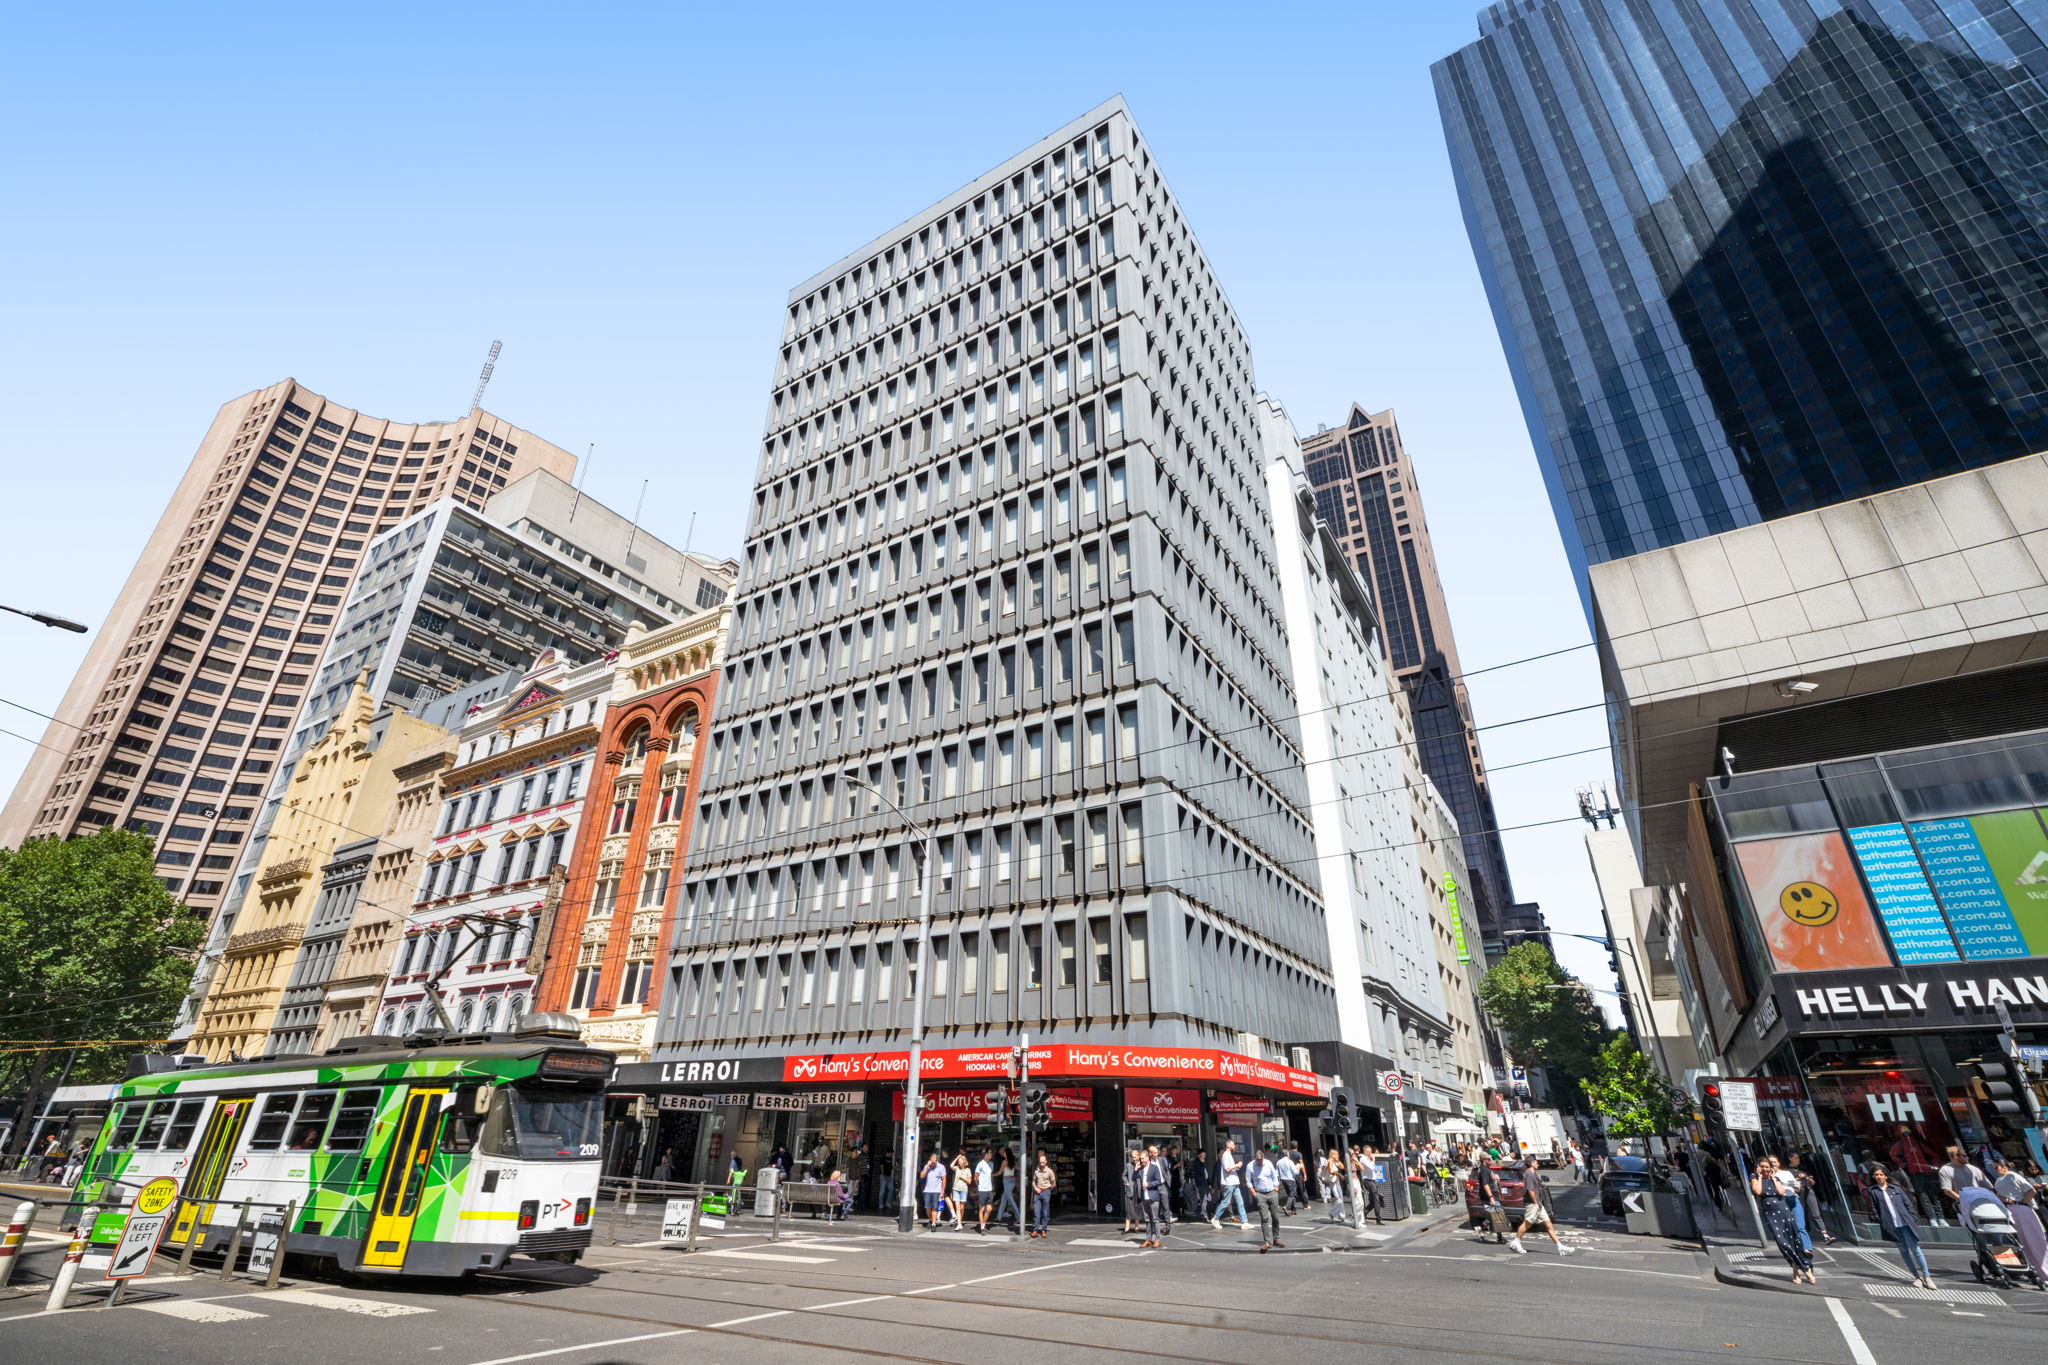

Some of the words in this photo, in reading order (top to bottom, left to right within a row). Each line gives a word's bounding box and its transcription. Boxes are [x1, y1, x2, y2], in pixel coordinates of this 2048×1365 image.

[204, 810, 214, 818] 12
[1796, 983, 1928, 1014] HELLY
[958, 1053, 994, 1062] AMERICAN
[1069, 1050, 1119, 1069] Harry's
[1124, 1052, 1214, 1070] Convenience
[661, 1061, 740, 1081] LERROI
[819, 1057, 860, 1076] Harry's
[864, 1056, 944, 1072] Convennce
[966, 1063, 996, 1071] HOOKAH
[1233, 1058, 1254, 1079] Harry's
[1255, 1063, 1286, 1082] Convenience
[1388, 1078, 1400, 1087] 20
[662, 1097, 712, 1109] LERROI
[718, 1095, 747, 1105] LERR
[757, 1096, 804, 1109] LERROI
[939, 1092, 980, 1111] Harry's
[1128, 1105, 1153, 1115] Harry's
[1154, 1106, 1199, 1114] Convenience
[1866, 1093, 1925, 1122] HH
[579, 1144, 599, 1156] 209
[500, 1169, 518, 1180] 209
[144, 1187, 173, 1196] SAFETY
[144, 1198, 165, 1208] ZONE
[667, 1202, 679, 1210] GIVE
[131, 1222, 158, 1231] KEEP
[128, 1233, 153, 1242] LEFT
